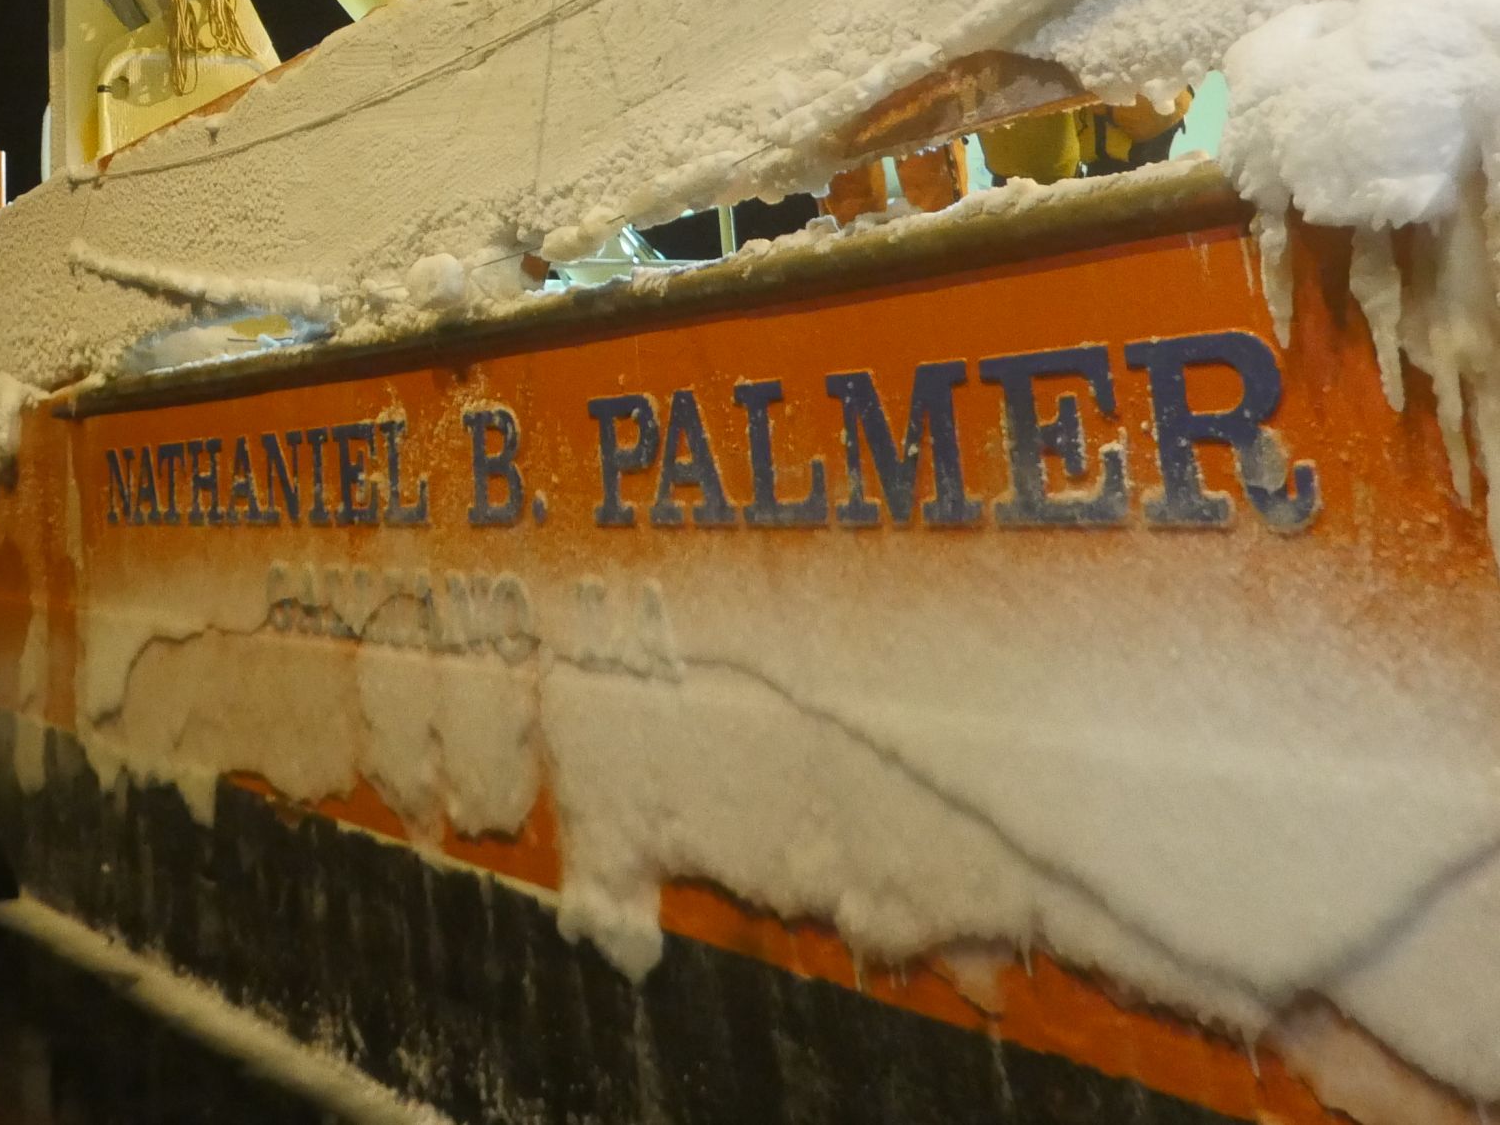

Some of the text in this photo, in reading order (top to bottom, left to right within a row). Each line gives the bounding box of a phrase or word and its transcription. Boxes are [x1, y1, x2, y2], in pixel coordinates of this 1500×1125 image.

[106, 329, 1320, 533] NATHANIEL B. PALMER
